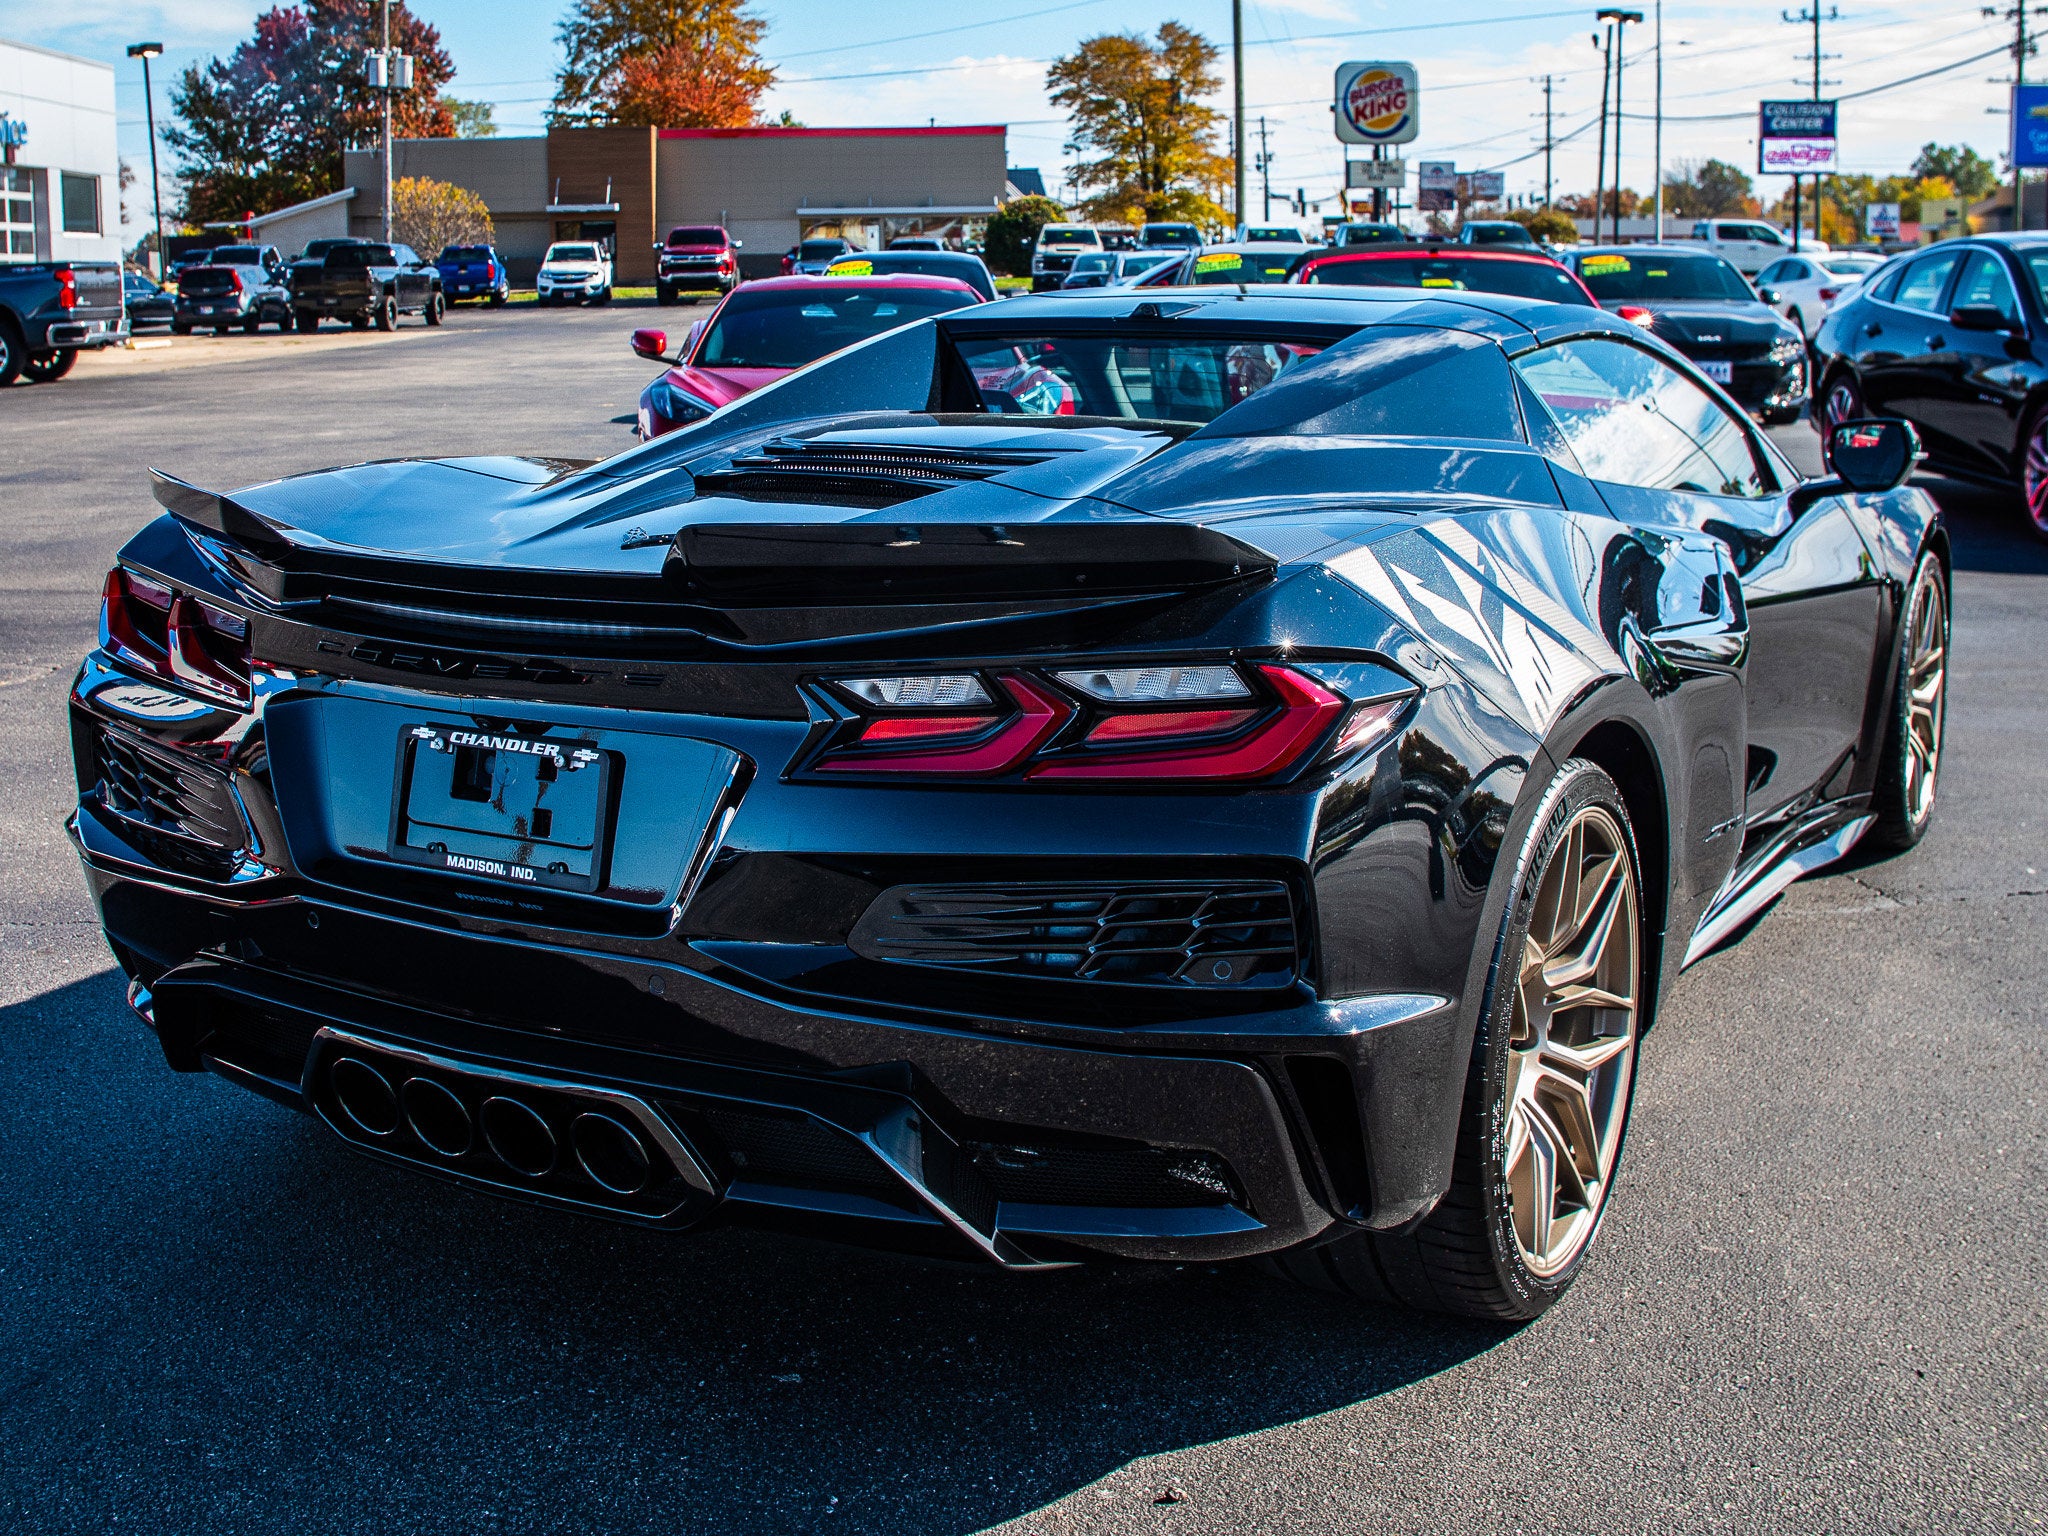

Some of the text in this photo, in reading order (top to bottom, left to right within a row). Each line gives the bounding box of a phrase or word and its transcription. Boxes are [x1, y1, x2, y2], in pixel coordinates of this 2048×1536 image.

[1350, 77, 1403, 104] BURGER
[1354, 92, 1407, 124] KING
[1764, 103, 1833, 117] COLLISION
[1771, 116, 1824, 130] CENTER
[317, 640, 667, 685] CORVETTE
[449, 731, 561, 757] CHANDLER
[1525, 798, 1567, 896] MICHELIN
[446, 855, 537, 881] MADISON, IND.
